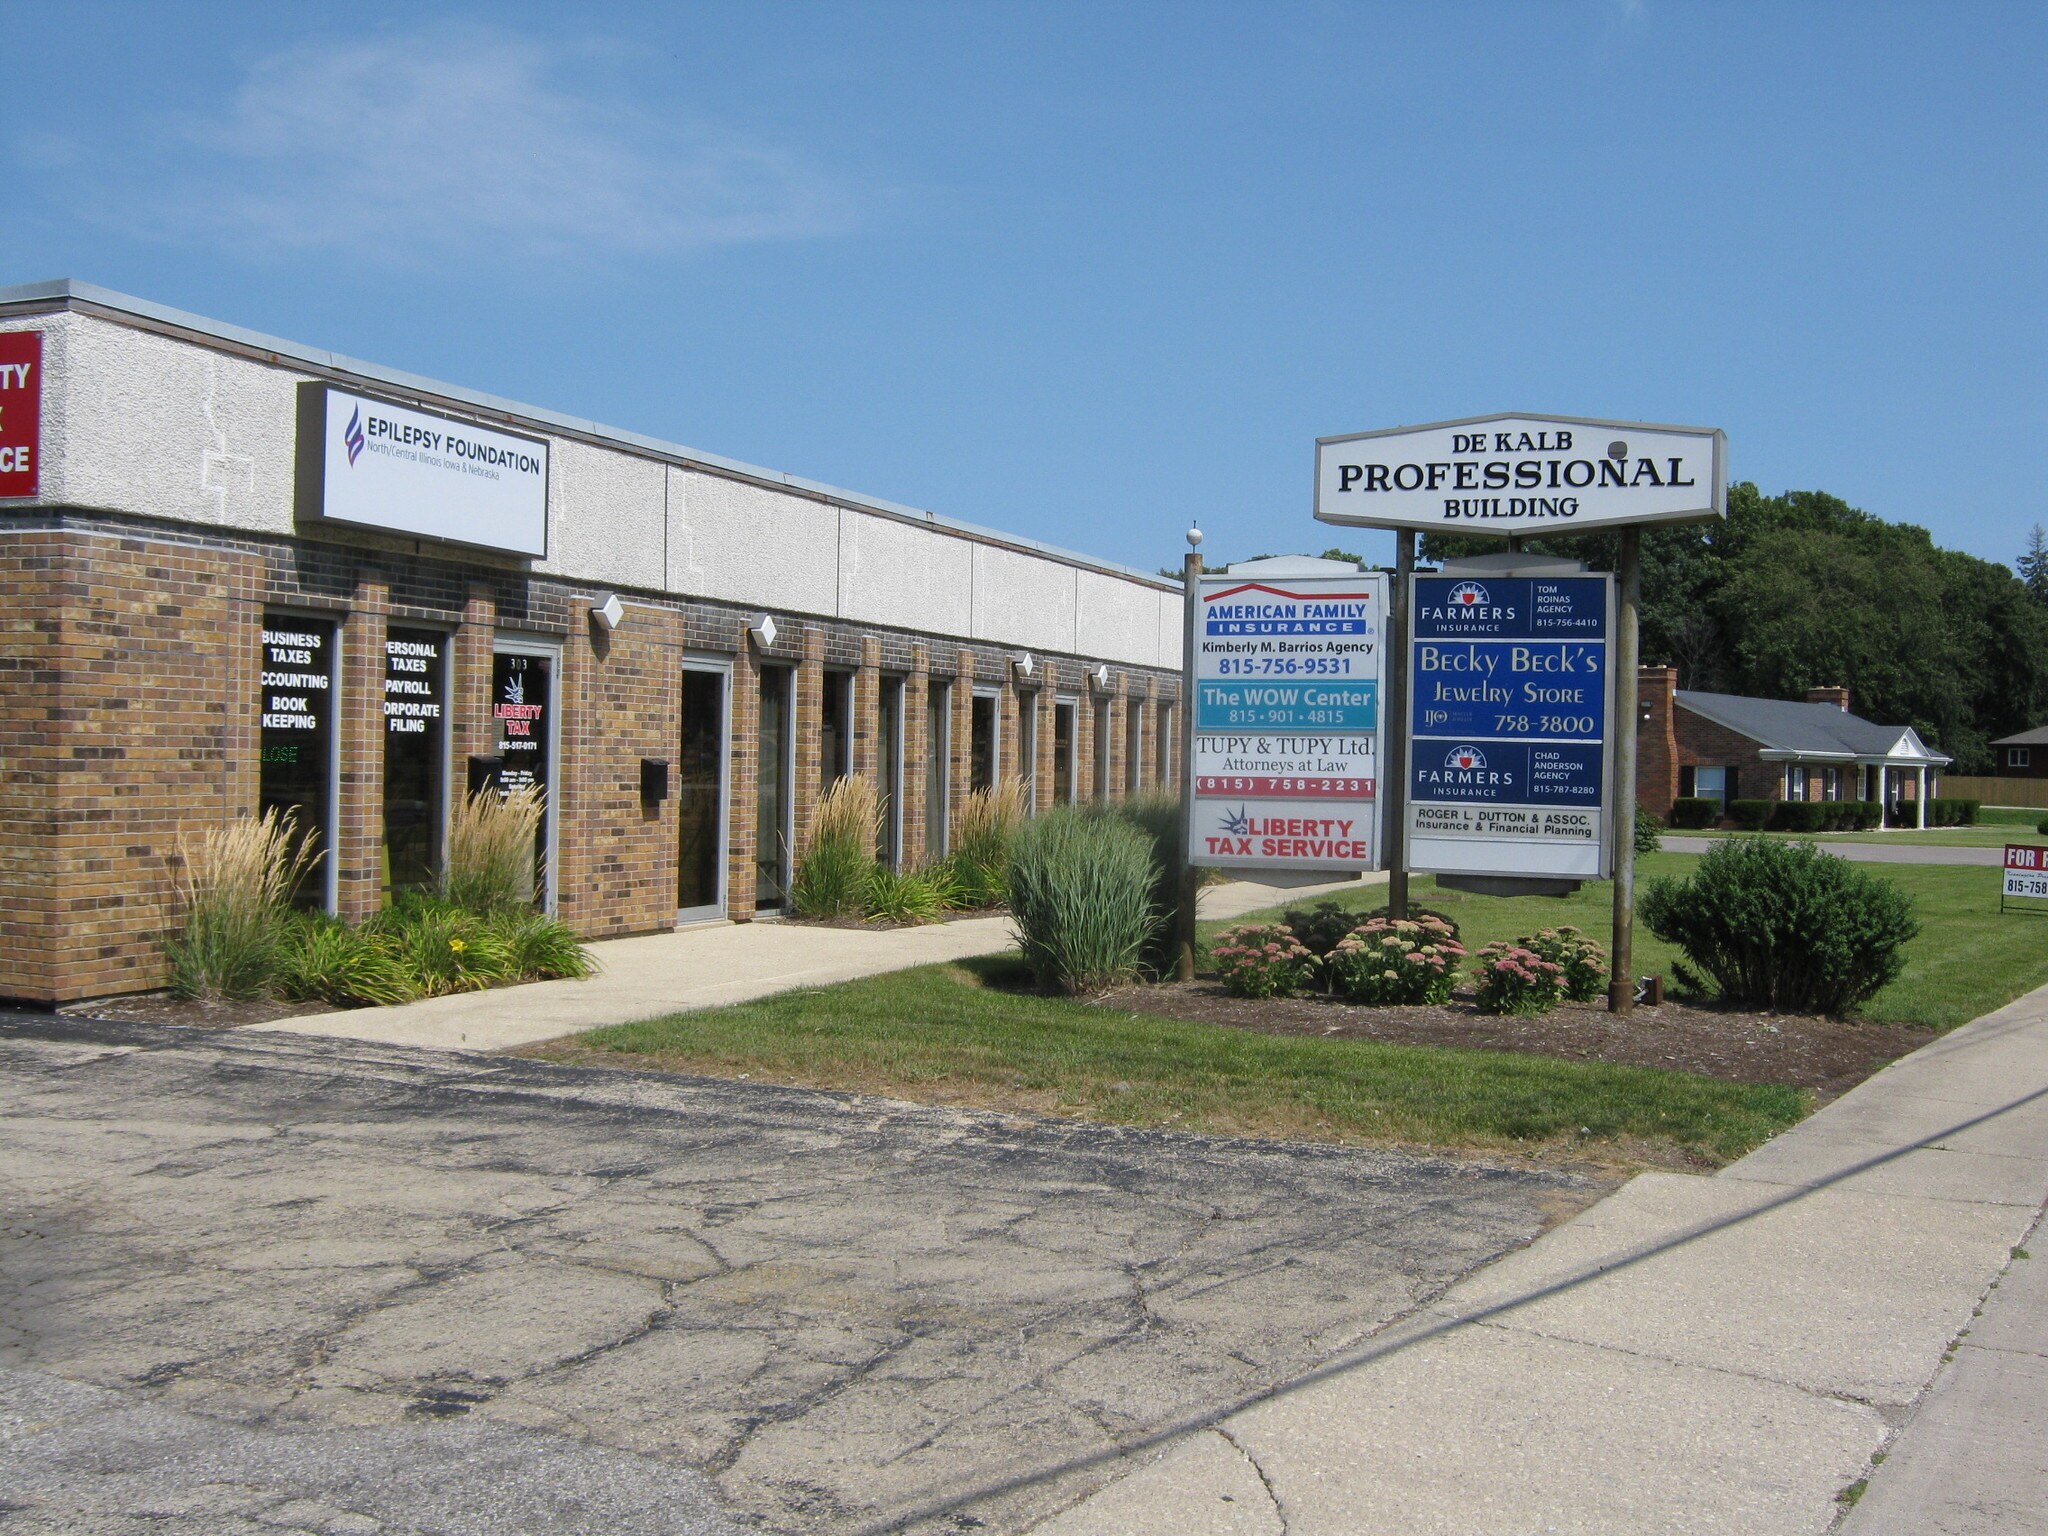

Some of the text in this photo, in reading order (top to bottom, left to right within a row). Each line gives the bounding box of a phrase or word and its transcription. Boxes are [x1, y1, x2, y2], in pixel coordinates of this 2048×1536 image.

[368, 417, 540, 475] EPILEPSY FOUNDATION
[1452, 431, 1573, 454] DE KALB
[367, 440, 500, 481] North/Central Illinois Iowa & Nebraska
[1338, 457, 1695, 493] PROFESSIONAL
[1443, 497, 1579, 518] BUILDING
[1538, 586, 1557, 594] TOM
[1207, 604, 1366, 619] AMERICAN FAMILY
[1421, 607, 1515, 620] FARMERS
[1537, 605, 1573, 613] AGENCY
[1219, 622, 1353, 633] INSURANCE
[1436, 624, 1500, 632] INSURANCE
[1537, 619, 1597, 627] 815-756-4410
[262, 630, 321, 648] BUSINESS
[271, 648, 311, 664] TAXES
[1202, 641, 1374, 655] Kimberly M. Barrios Agency
[391, 657, 427, 673] TAXES
[510, 658, 528, 670] 303
[1219, 658, 1351, 674] 815-756-9531
[261, 671, 328, 689] CCOUNTING
[385, 680, 431, 695] PAYROLL
[272, 696, 308, 711] BOOK
[1204, 688, 1371, 706] The WOW Center
[384, 702, 440, 717] ORPORATE
[494, 703, 542, 720] LIBERTY
[263, 714, 316, 729] KEEPING
[390, 718, 425, 732] FILING
[506, 720, 530, 736] TAX
[1495, 715, 1594, 733] 758-3800
[263, 746, 298, 762] LOSE
[1197, 737, 1375, 756] TUPY & TUPY Ltd.
[1535, 752, 1560, 760] CHAD
[1222, 757, 1348, 774] Attorneys at Law
[1534, 762, 1583, 771] ANDERSON
[1418, 770, 1513, 785] FARMERS
[1533, 772, 1570, 780] AGENCY
[1196, 778, 1372, 791] (815) 758-2231
[1433, 787, 1497, 797] INSURANCE
[1533, 785, 1595, 795] 815-787-8280
[1418, 809, 1591, 826] ROGER L. DUTTON & ASSOC.
[1248, 818, 1354, 837] LIBERTY
[1416, 819, 1592, 838] Insurance & Financial Planning
[1205, 837, 1367, 859] TAX SERVICE
[2007, 848, 2035, 867] FOR
